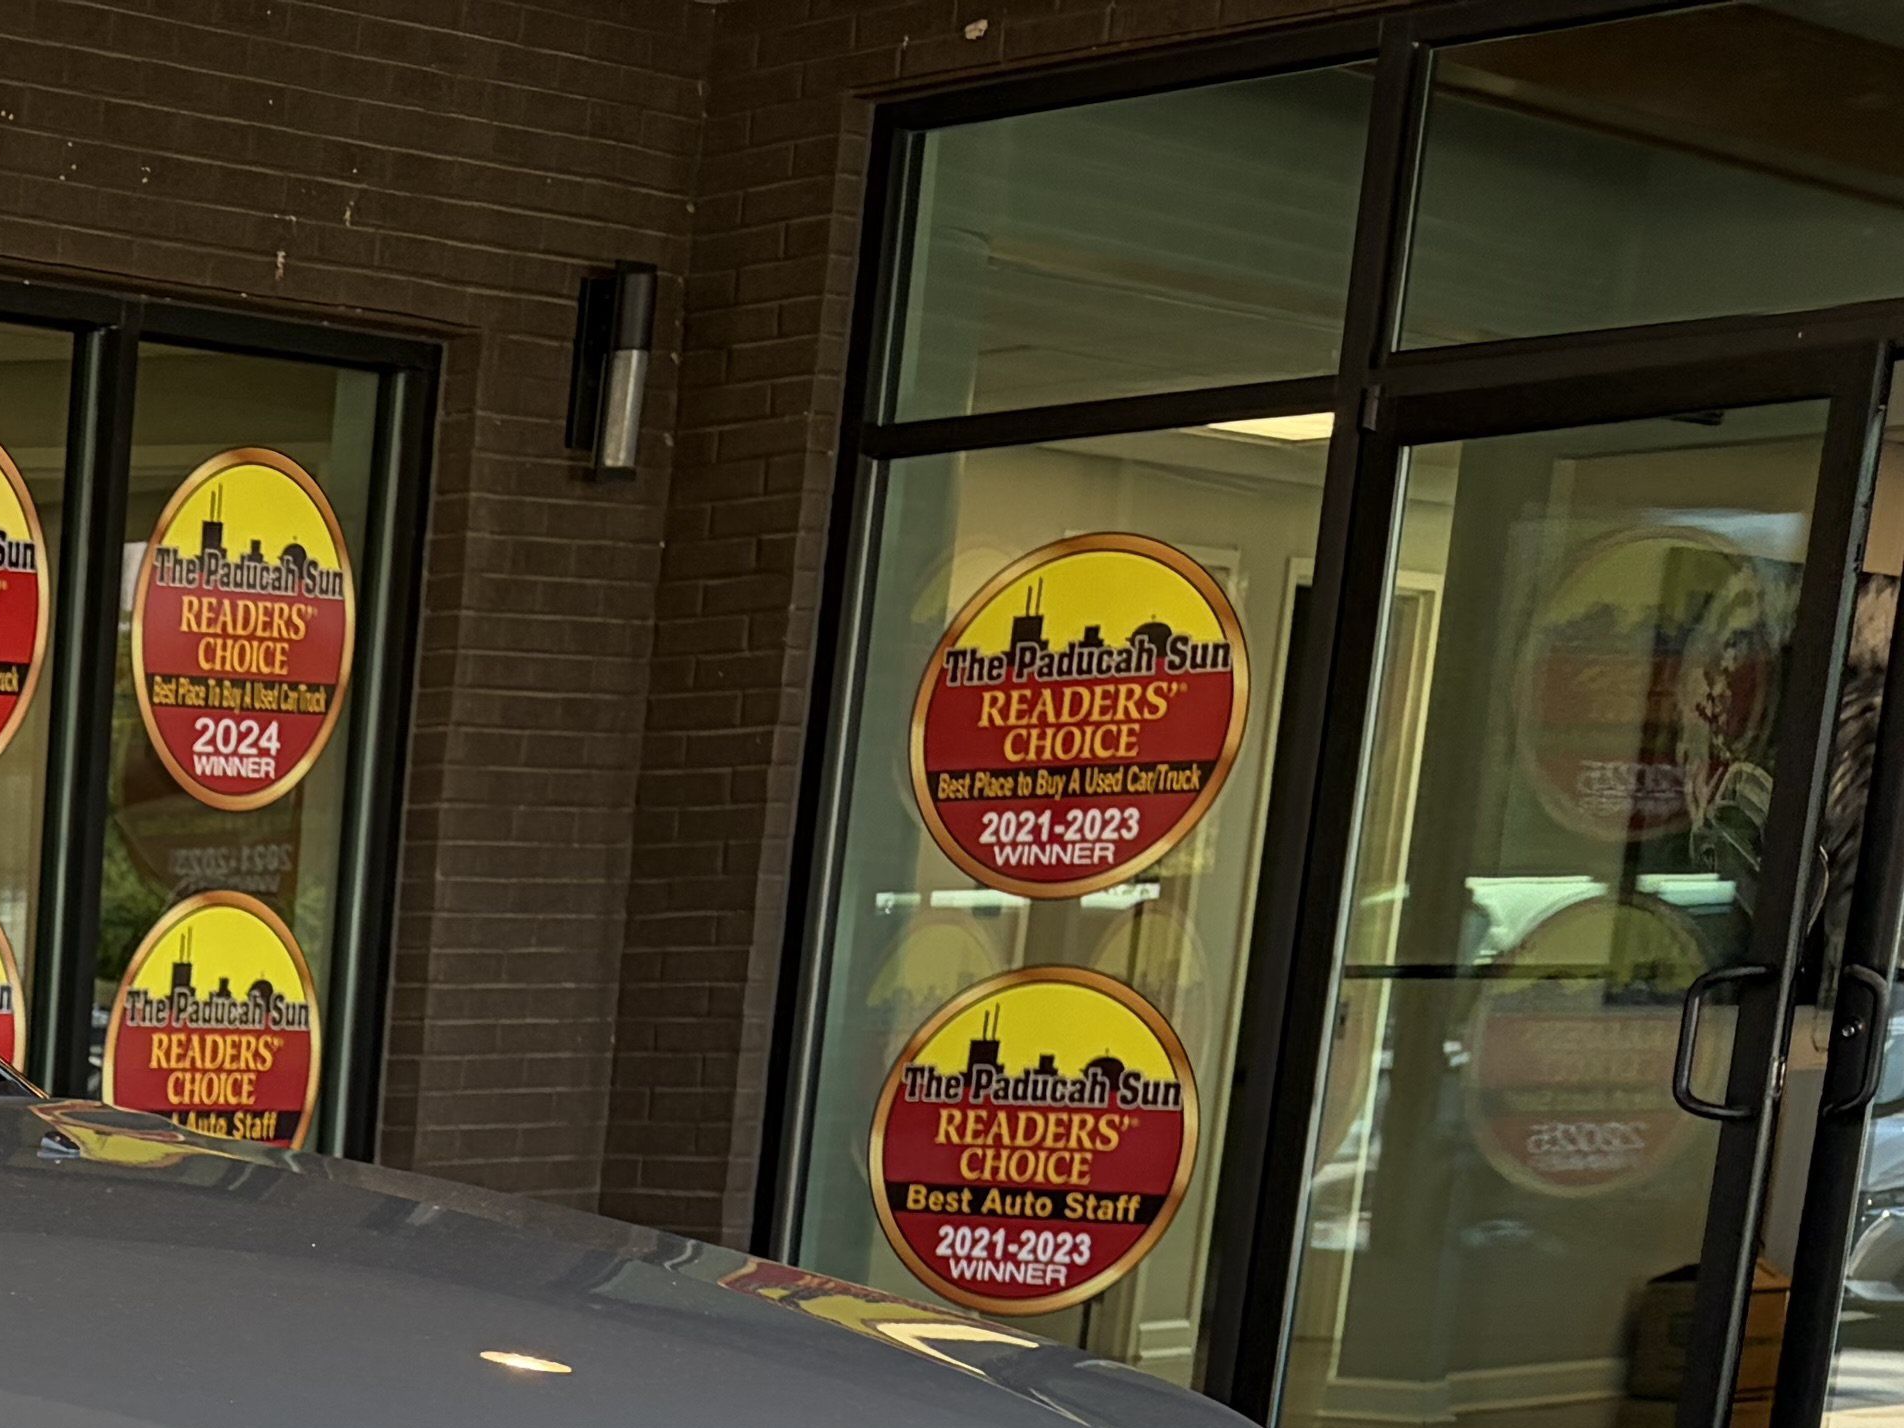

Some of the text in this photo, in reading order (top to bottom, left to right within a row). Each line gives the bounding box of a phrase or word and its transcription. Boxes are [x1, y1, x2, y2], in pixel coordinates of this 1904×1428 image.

[154, 545, 343, 600] The Paducah Sun
[198, 637, 289, 675] CHOICE
[944, 634, 1232, 687] The Paducah Sun
[153, 675, 176, 704] Best
[178, 676, 206, 706] Place
[223, 680, 241, 714] Buy
[243, 680, 252, 709] A
[254, 680, 279, 710] Used
[192, 717, 281, 756] 2024
[1003, 723, 1140, 763] CHOICE
[192, 754, 275, 779] WINNER
[938, 763, 1201, 800] Best Place to Buy A Used Car/Truck
[978, 806, 1140, 845] 2021-2023
[994, 842, 1115, 867] WINNER
[124, 986, 309, 1031] The Paducah Sun
[167, 1071, 257, 1105] CHOICE
[903, 1063, 1183, 1111] The Paducah Sun
[185, 1111, 228, 1137] Auto
[232, 1111, 278, 1140] Staff
[959, 1147, 1093, 1186] CHOICE
[906, 1183, 1140, 1222] Best Auto Staff
[936, 1225, 1092, 1265] 2021-2023
[949, 1257, 1067, 1286] WINNER
